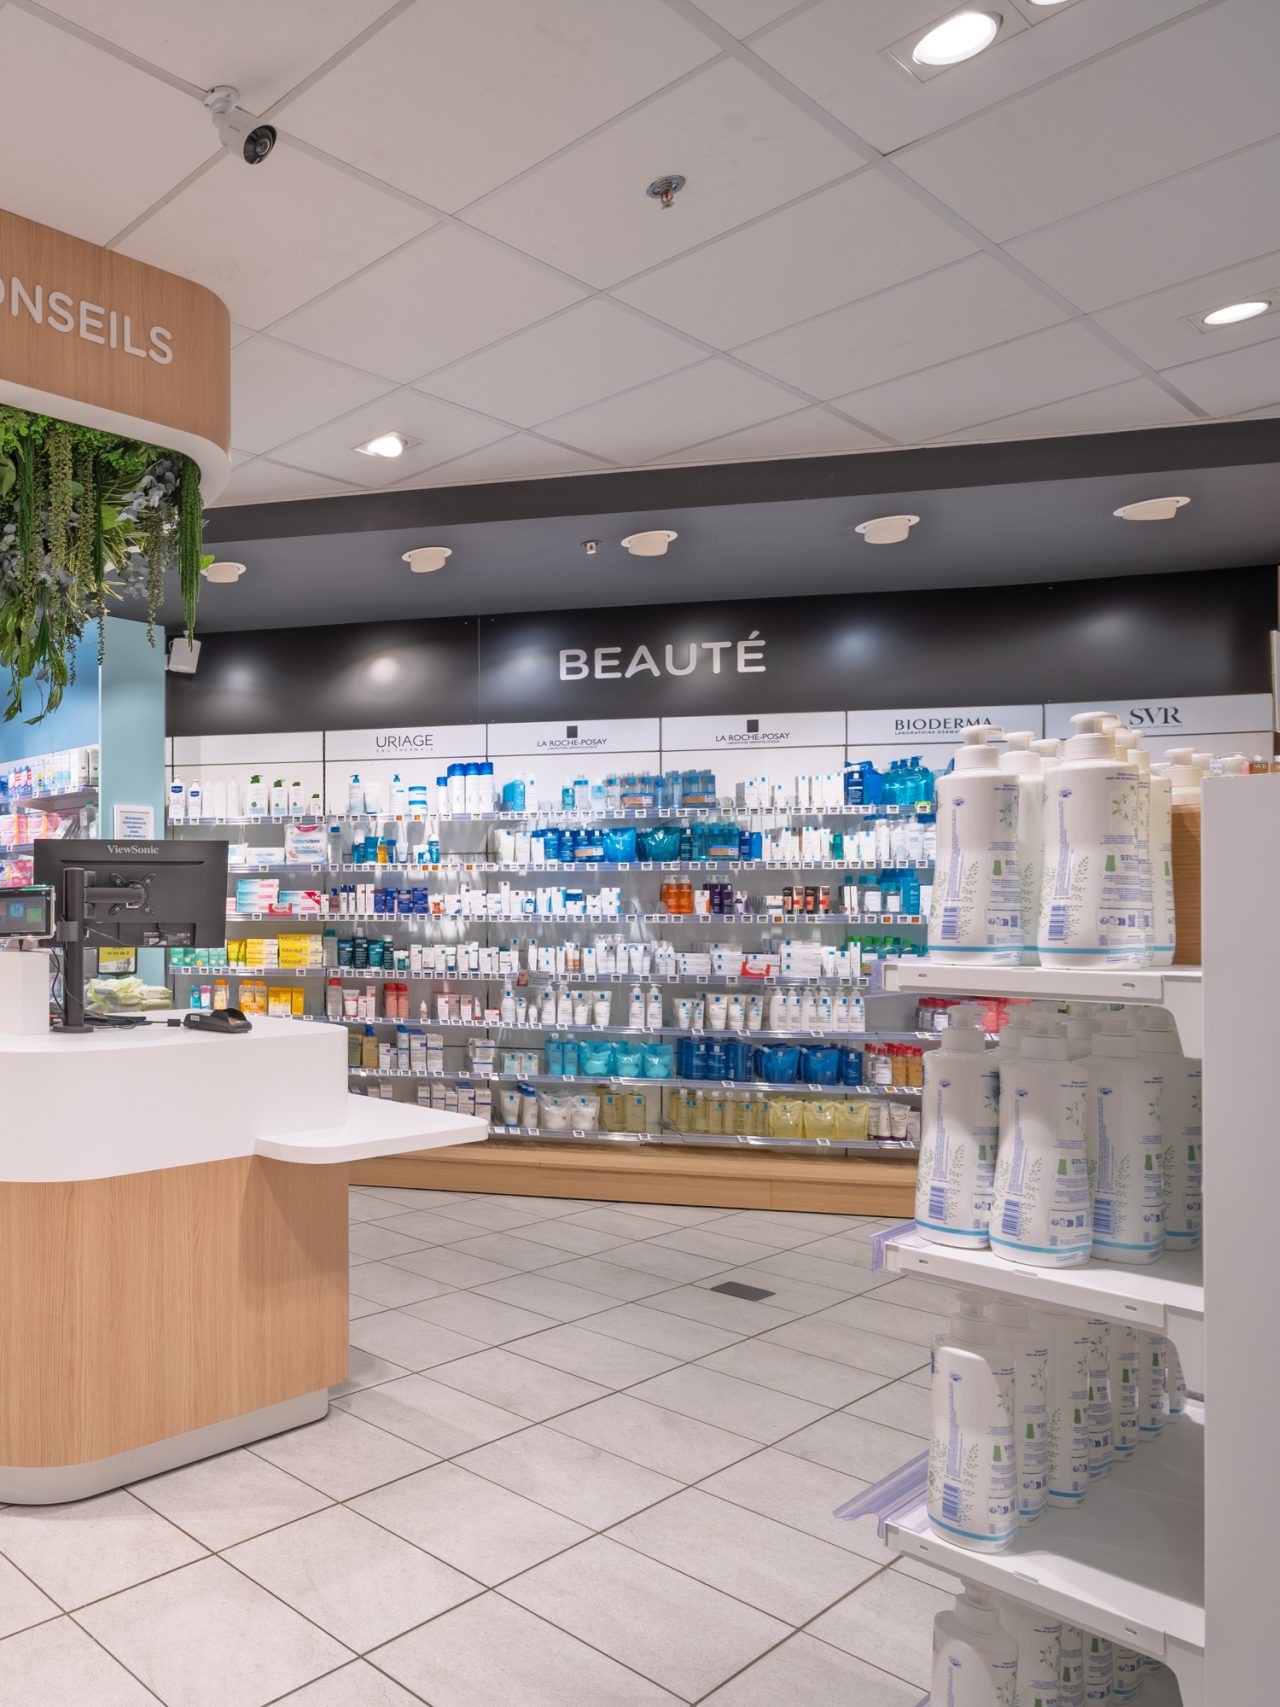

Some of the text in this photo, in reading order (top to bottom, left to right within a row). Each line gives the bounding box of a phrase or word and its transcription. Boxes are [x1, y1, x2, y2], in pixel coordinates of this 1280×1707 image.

[559, 630, 766, 681] BEAUTÉ
[1130, 707, 1182, 725] SVR
[895, 718, 991, 730] BIODERMA
[376, 735, 434, 748] URIAGE
[549, 738, 607, 746] ROCHE-POSAY
[106, 845, 159, 854] ViewSonic
